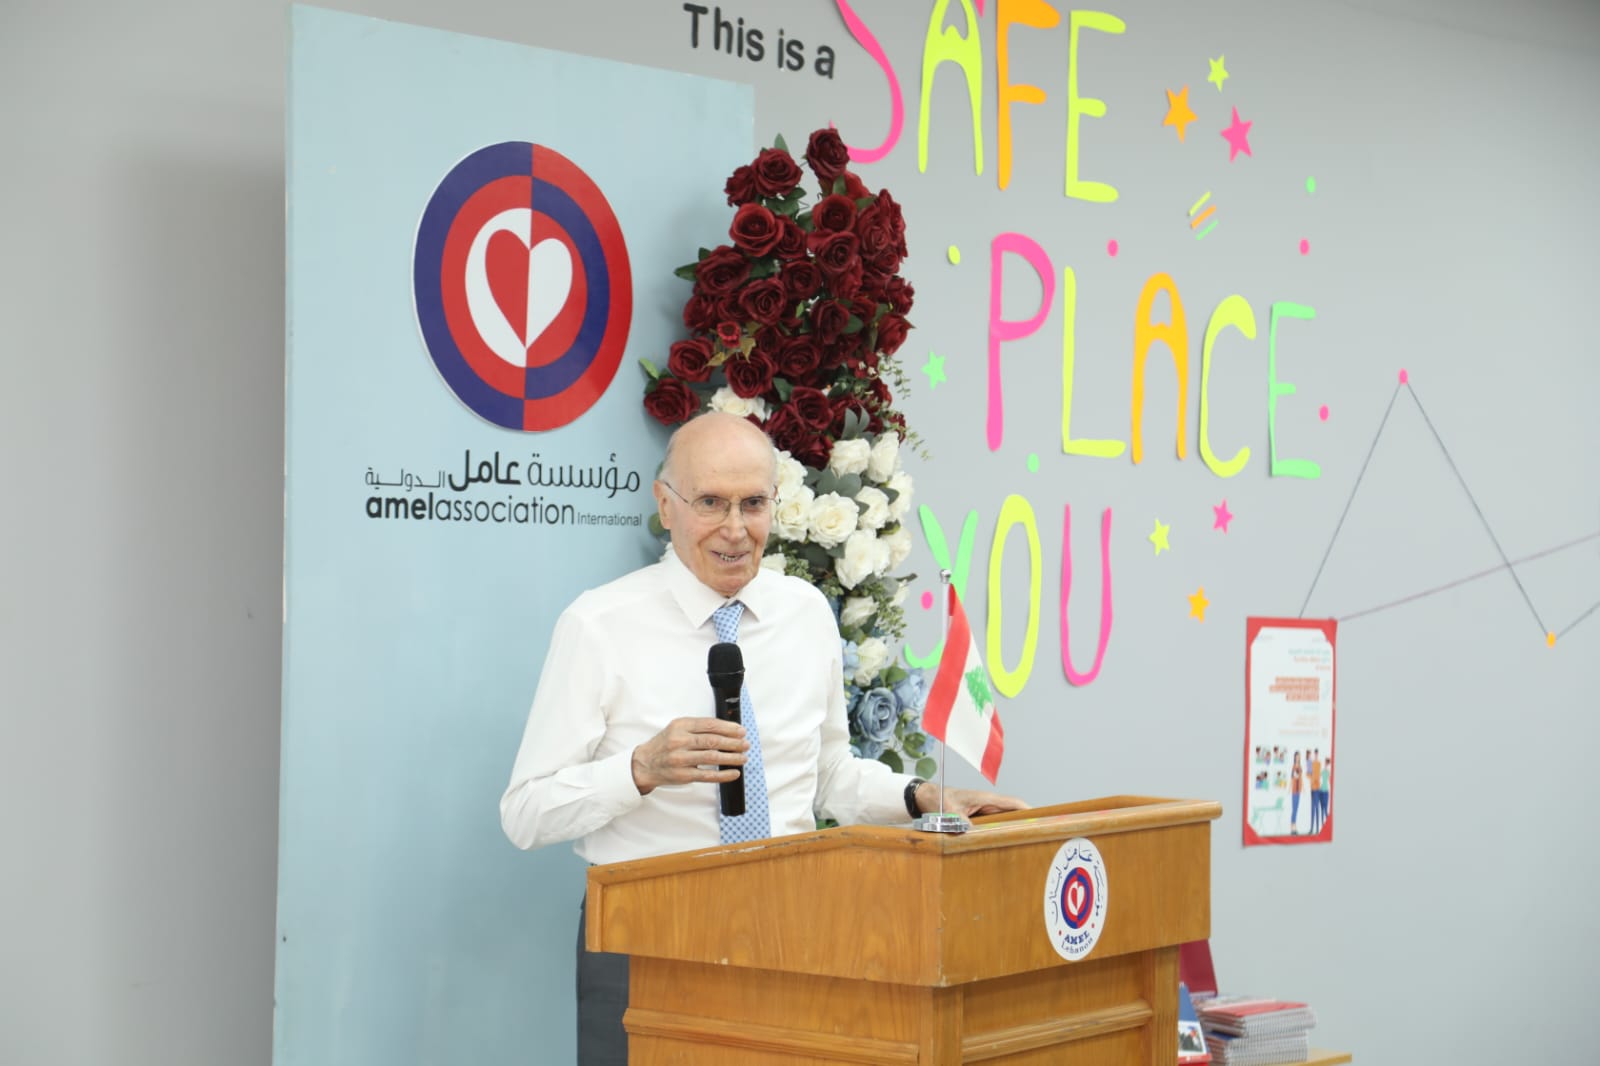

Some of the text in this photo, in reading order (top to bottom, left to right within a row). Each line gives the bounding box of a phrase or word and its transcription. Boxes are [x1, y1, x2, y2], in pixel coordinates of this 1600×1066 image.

[683, 3, 836, 80] This is a
[828, 0, 1127, 203] SAFE
[986, 231, 1321, 479] PLACE
[364, 449, 641, 499] مؤسسة عامل الدولية
[577, 511, 643, 527] International
[904, 493, 1114, 699] YOU
[1064, 930, 1090, 945] AMEL
